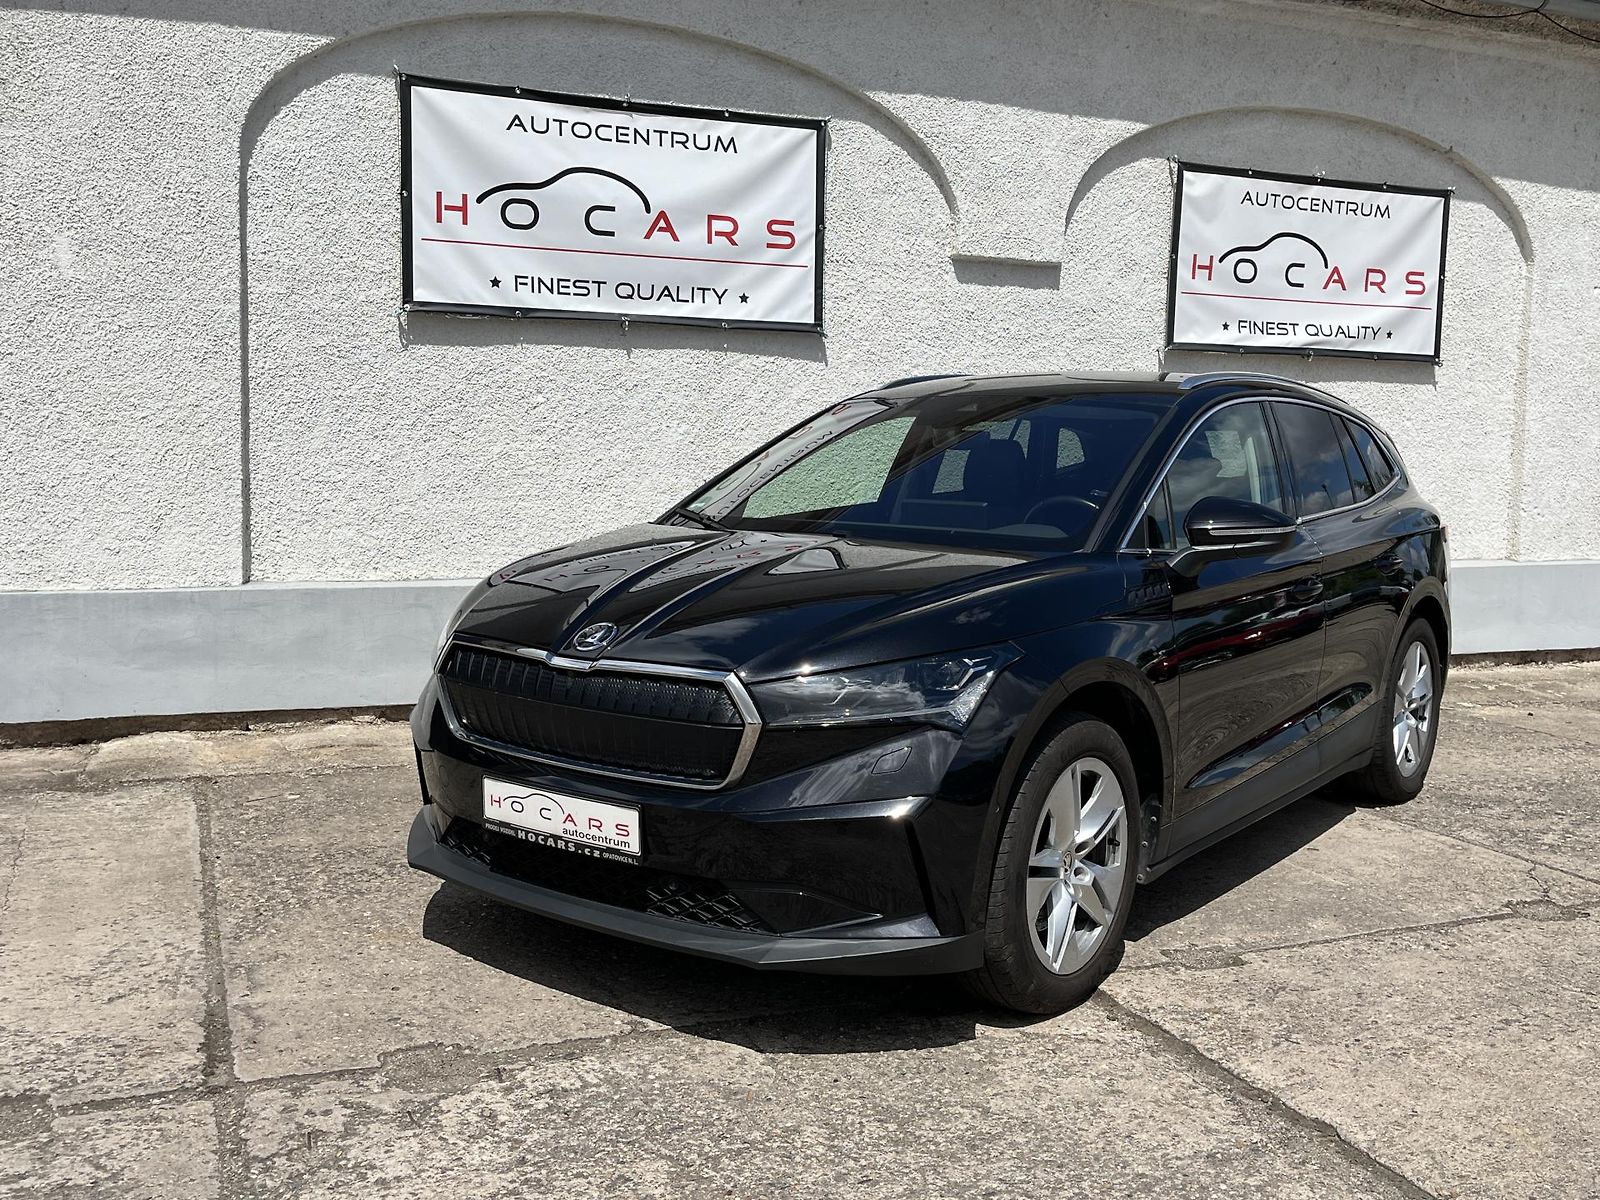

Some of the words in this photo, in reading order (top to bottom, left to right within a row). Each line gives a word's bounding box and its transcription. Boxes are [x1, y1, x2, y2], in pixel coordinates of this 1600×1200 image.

[506, 113, 738, 154] AUTOCENTRUM
[1240, 191, 1391, 219] AUTOCENTRUM
[514, 275, 607, 299] FINEST
[614, 281, 729, 305] QUALITY
[1237, 319, 1300, 337] FINEST
[1304, 323, 1382, 341] QUALITY
[562, 827, 631, 849] autocentrum
